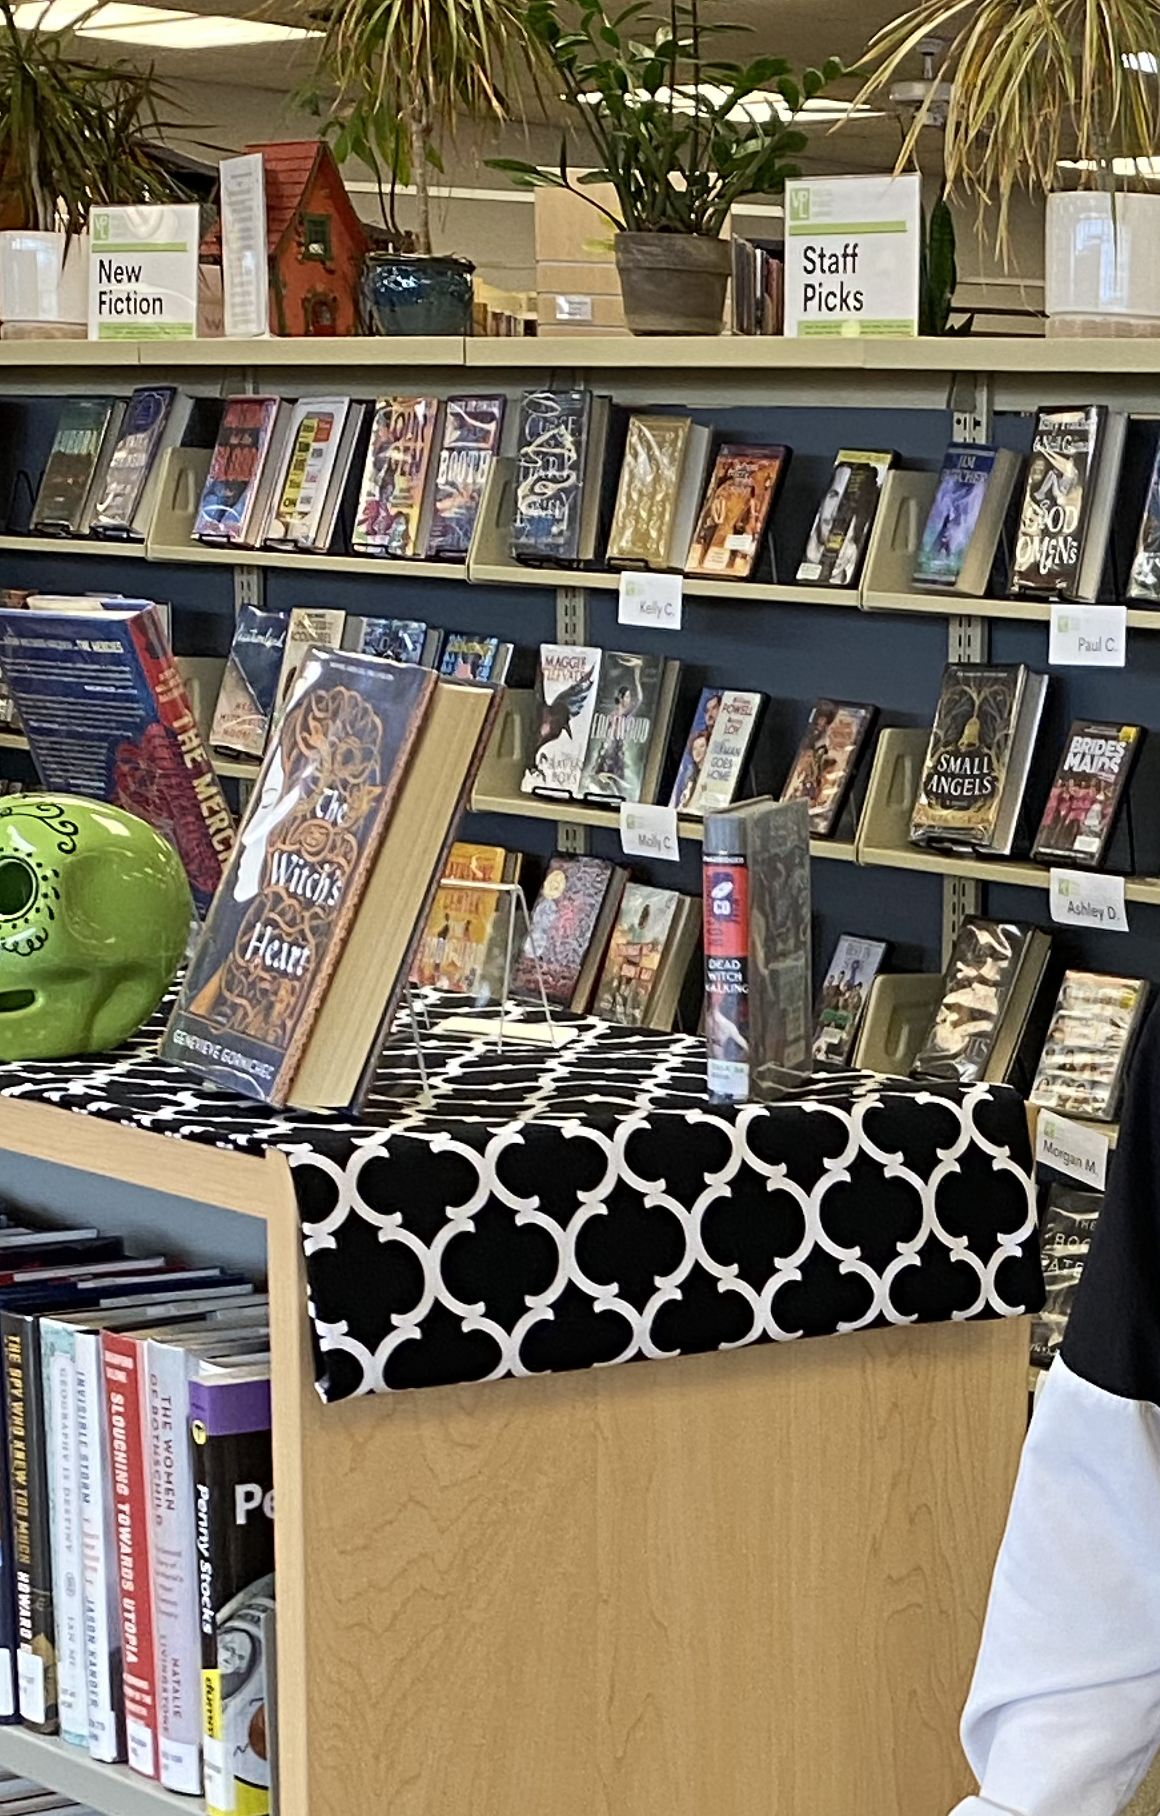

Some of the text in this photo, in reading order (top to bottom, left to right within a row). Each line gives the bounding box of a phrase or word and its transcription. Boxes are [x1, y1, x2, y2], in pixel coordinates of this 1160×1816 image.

[98, 259, 142, 284] New
[803, 243, 859, 275] Staff
[98, 290, 163, 315] Fiction
[803, 281, 864, 313] Picks
[1078, 636, 1118, 652] Paul C.
[544, 655, 587, 671] MAGGIE
[722, 702, 753, 716] POWELL
[710, 757, 732, 769] GOES
[1072, 736, 1126, 758] BRIDES
[708, 770, 731, 781] HOME
[937, 753, 990, 775] SMALL
[1063, 752, 1121, 775] MAIDS
[172, 709, 237, 865] THE MERC
[927, 774, 993, 797] ANGELS
[315, 787, 348, 825] The
[638, 832, 661, 850] Molly
[270, 850, 344, 906] Witch's
[1067, 899, 1121, 921] Ashley D.
[245, 921, 312, 977] Heart
[707, 959, 741, 970] DEAD
[707, 970, 743, 982] WITCH
[172, 1029, 222, 1060] GENEVIEVE
[1043, 1138, 1100, 1176] Morgan M.
[1075, 1218, 1097, 1231] THE
[59, 1368, 70, 1459] GEOGRAPHY
[9, 1335, 31, 1565] THE SPY WHO KNEW TOO MUCH
[76, 1371, 91, 1504] INVISIBLE STORM
[150, 1373, 163, 1527] OF ROTHSCHILD
[160, 1396, 176, 1511] THE WOMEN
[63, 1487, 73, 1552] DESTINY
[110, 1392, 139, 1664] SLOUCHING TOWARDS UTOPIA
[196, 1483, 214, 1636] Penny Stocks
[17, 1571, 33, 1640] HOWARD
[85, 1598, 97, 1646] JASON
[171, 1657, 182, 1719] NATALIE
